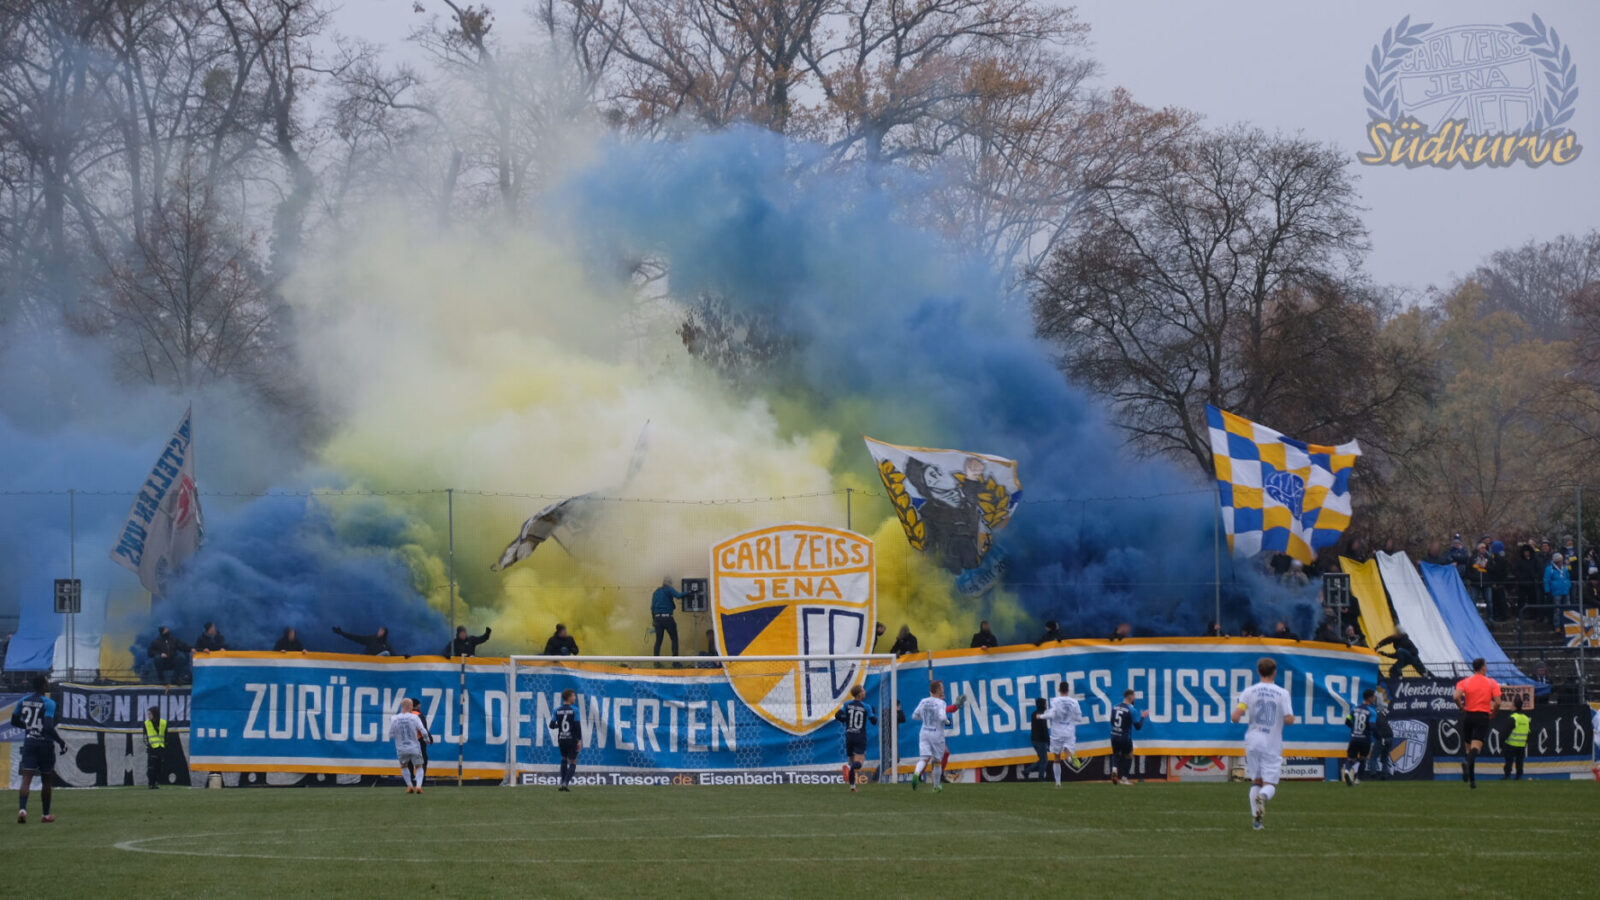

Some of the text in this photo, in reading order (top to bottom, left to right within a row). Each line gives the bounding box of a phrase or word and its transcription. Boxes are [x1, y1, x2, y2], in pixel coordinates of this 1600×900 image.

[721, 534, 865, 571] CARL ZEISS
[745, 576, 842, 602] JENA
[1500, 692, 1530, 702] ATAR
[243, 675, 407, 743] ZURÜCK
[420, 687, 469, 744] ZU
[484, 689, 561, 748] DEN
[577, 693, 737, 753] WERTEN
[1127, 667, 1361, 725] FUSSBLS!
[848, 708, 864, 729] 10
[1114, 710, 1123, 728] 5
[1255, 699, 1278, 727] 20
[561, 713, 570, 732] 6
[1353, 711, 1367, 732] 18
[699, 771, 869, 785] Eisenbach Tresoree
